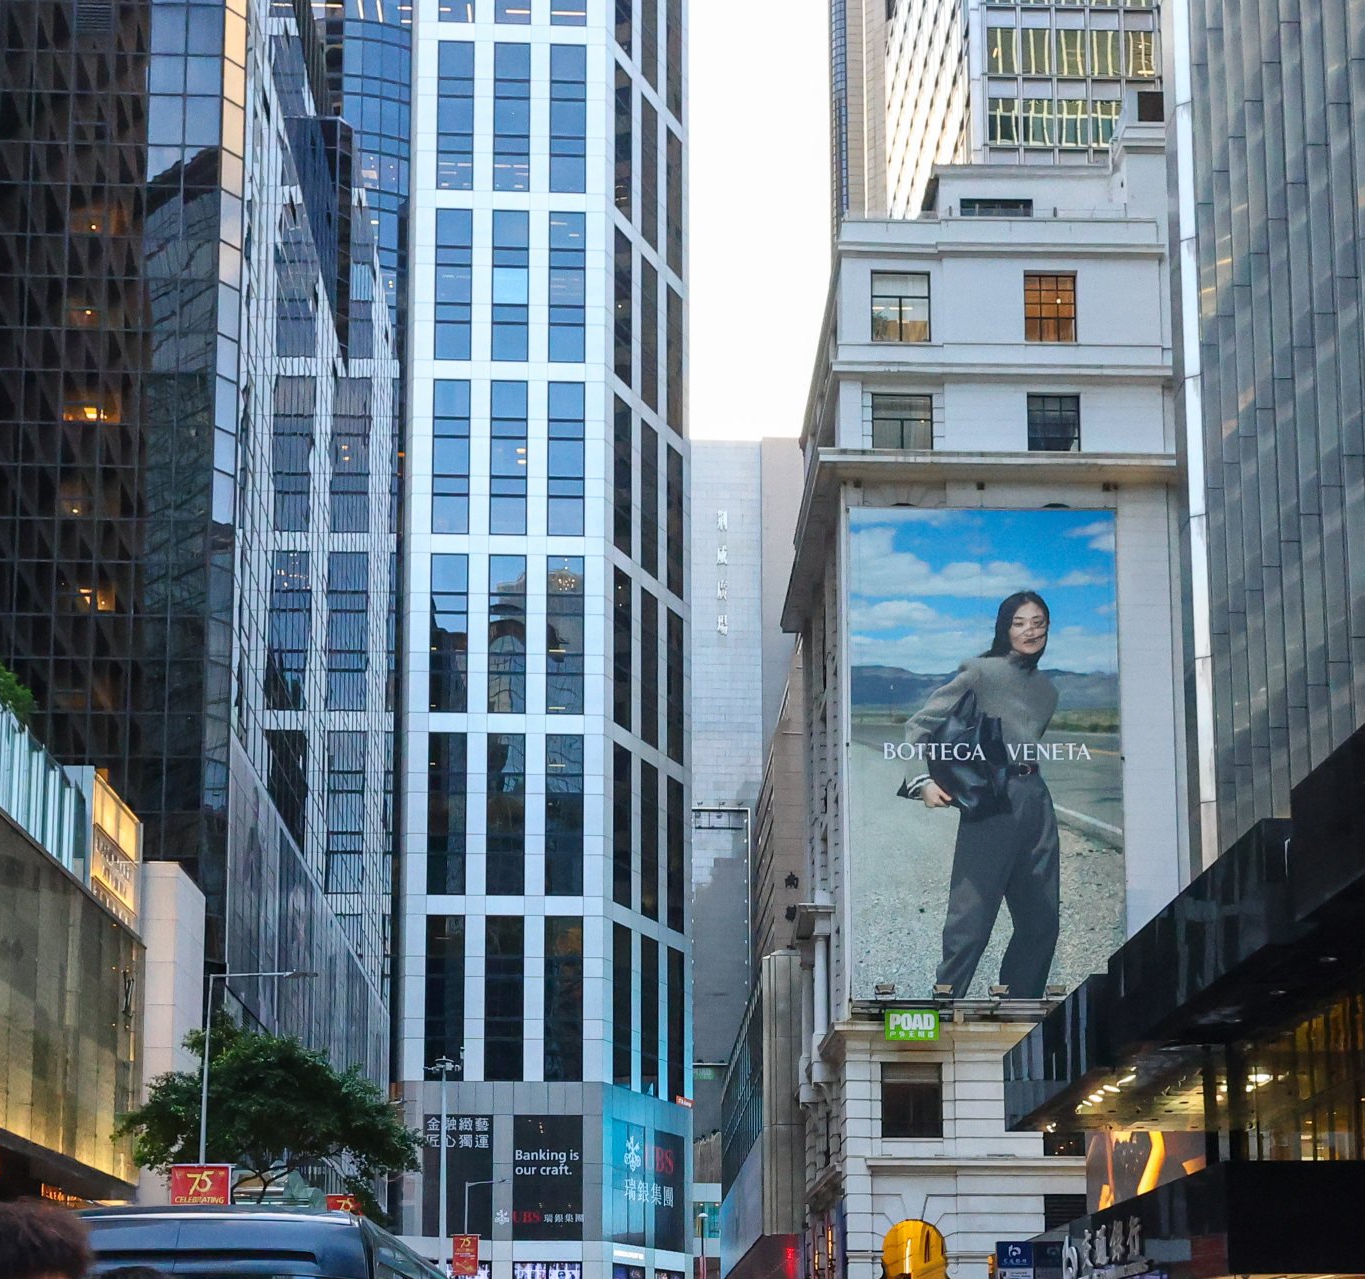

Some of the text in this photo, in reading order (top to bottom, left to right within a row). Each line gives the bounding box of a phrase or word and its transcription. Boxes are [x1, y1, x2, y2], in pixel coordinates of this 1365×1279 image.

[883, 742, 1092, 761] BOTTEGA VENETA
[889, 1013, 935, 1030] POAD
[426, 1134, 489, 1149] 匠心獨運
[515, 1149, 580, 1164] Banking is
[645, 1144, 674, 1174] UBS
[515, 1163, 573, 1175] our craft.
[186, 1170, 214, 1195] 75
[174, 1195, 225, 1204] CELEBRATING
[624, 1178, 674, 1208] 瑞銀集團
[513, 1210, 540, 1224] UBS
